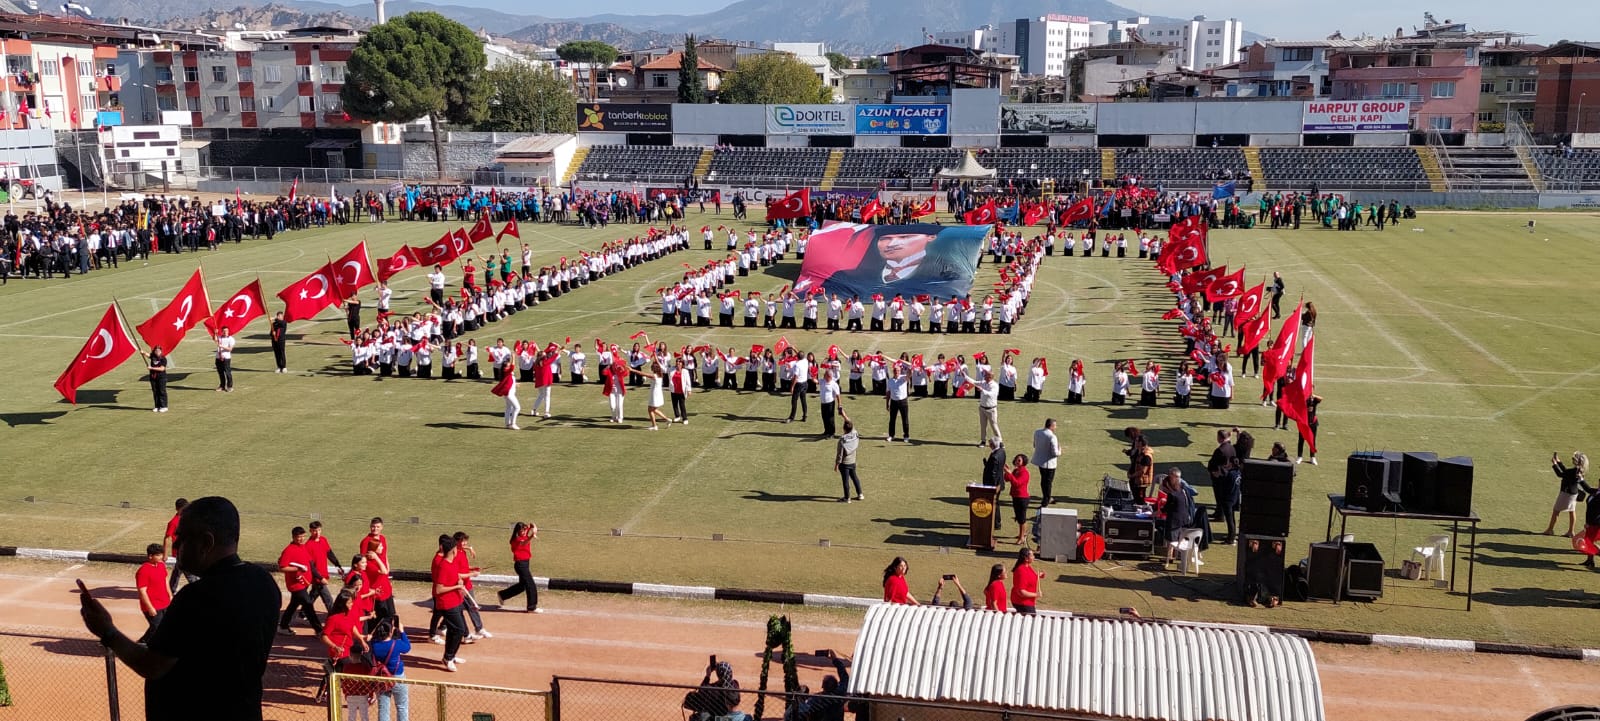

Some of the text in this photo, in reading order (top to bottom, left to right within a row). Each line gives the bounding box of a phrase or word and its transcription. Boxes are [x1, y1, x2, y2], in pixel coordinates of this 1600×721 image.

[859, 106, 944, 117] AZUN TİCARET
[1309, 102, 1405, 113] HARPUT GROUP
[796, 111, 846, 122] DORTEL
